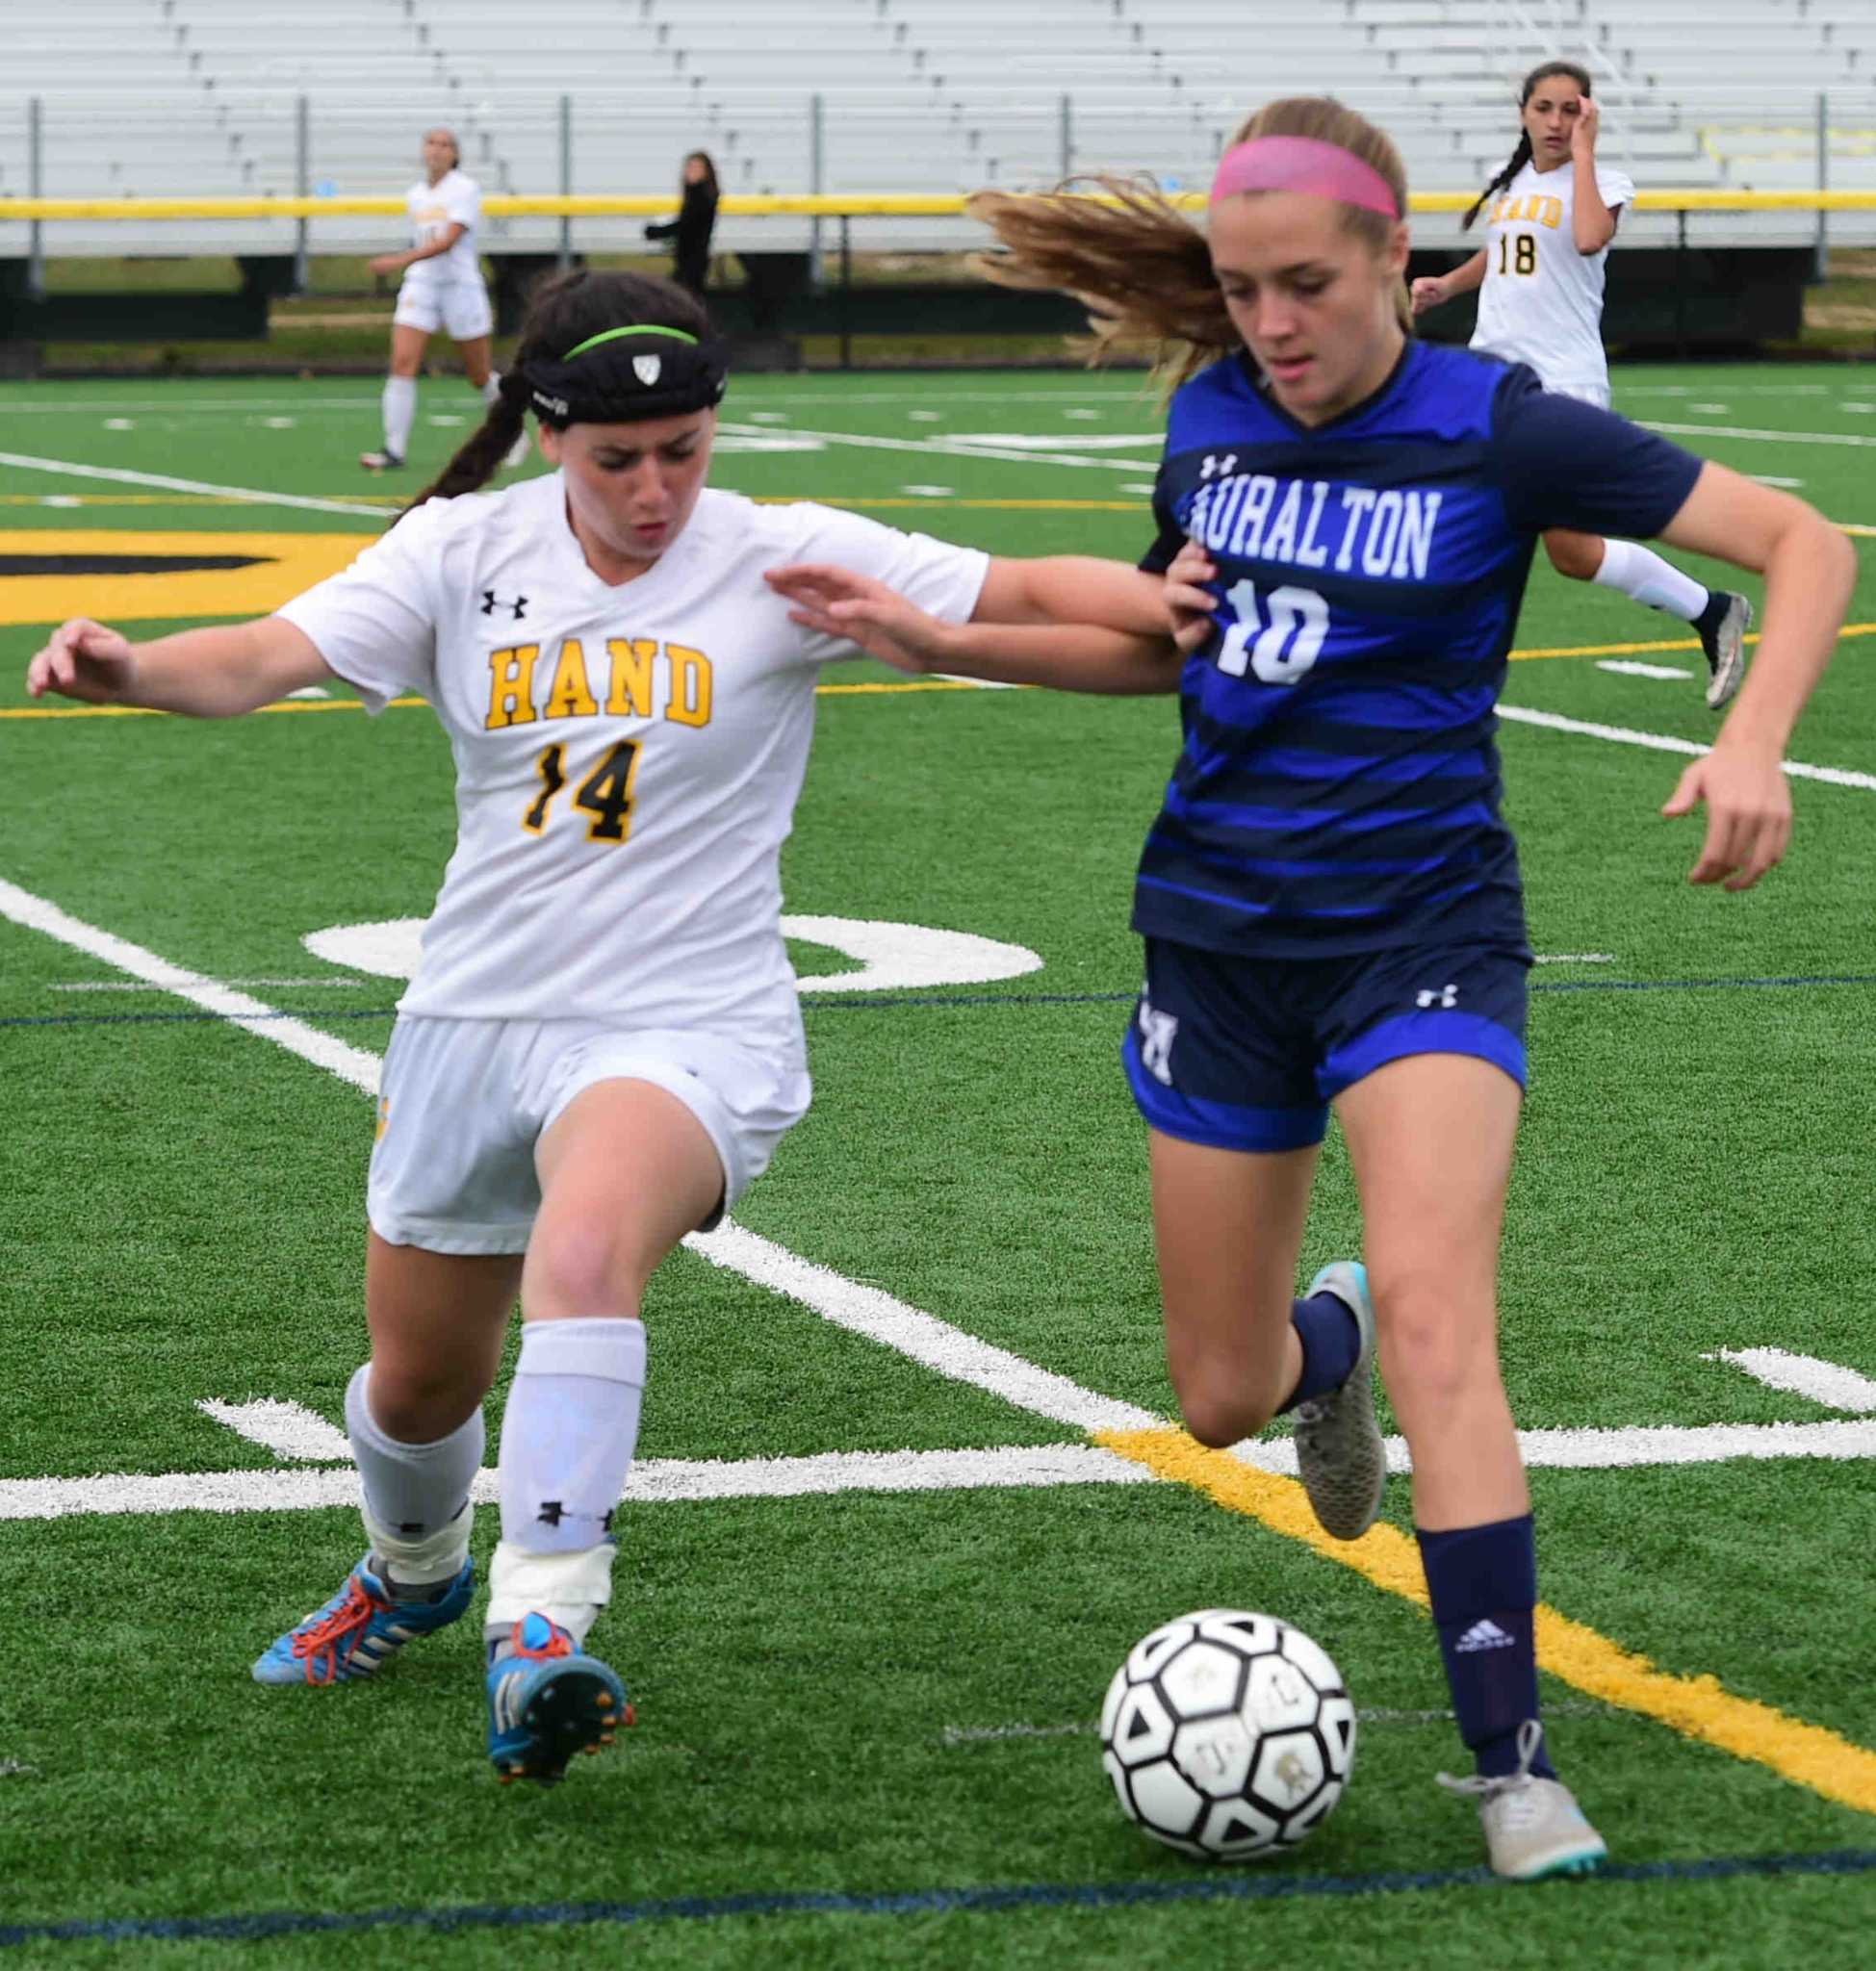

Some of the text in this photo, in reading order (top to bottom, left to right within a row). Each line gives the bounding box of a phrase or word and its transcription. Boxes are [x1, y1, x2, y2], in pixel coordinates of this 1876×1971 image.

[1498, 233, 1535, 275] 18
[1217, 578, 1330, 685] 10
[484, 637, 713, 730] HAND
[521, 738, 644, 844] 14
